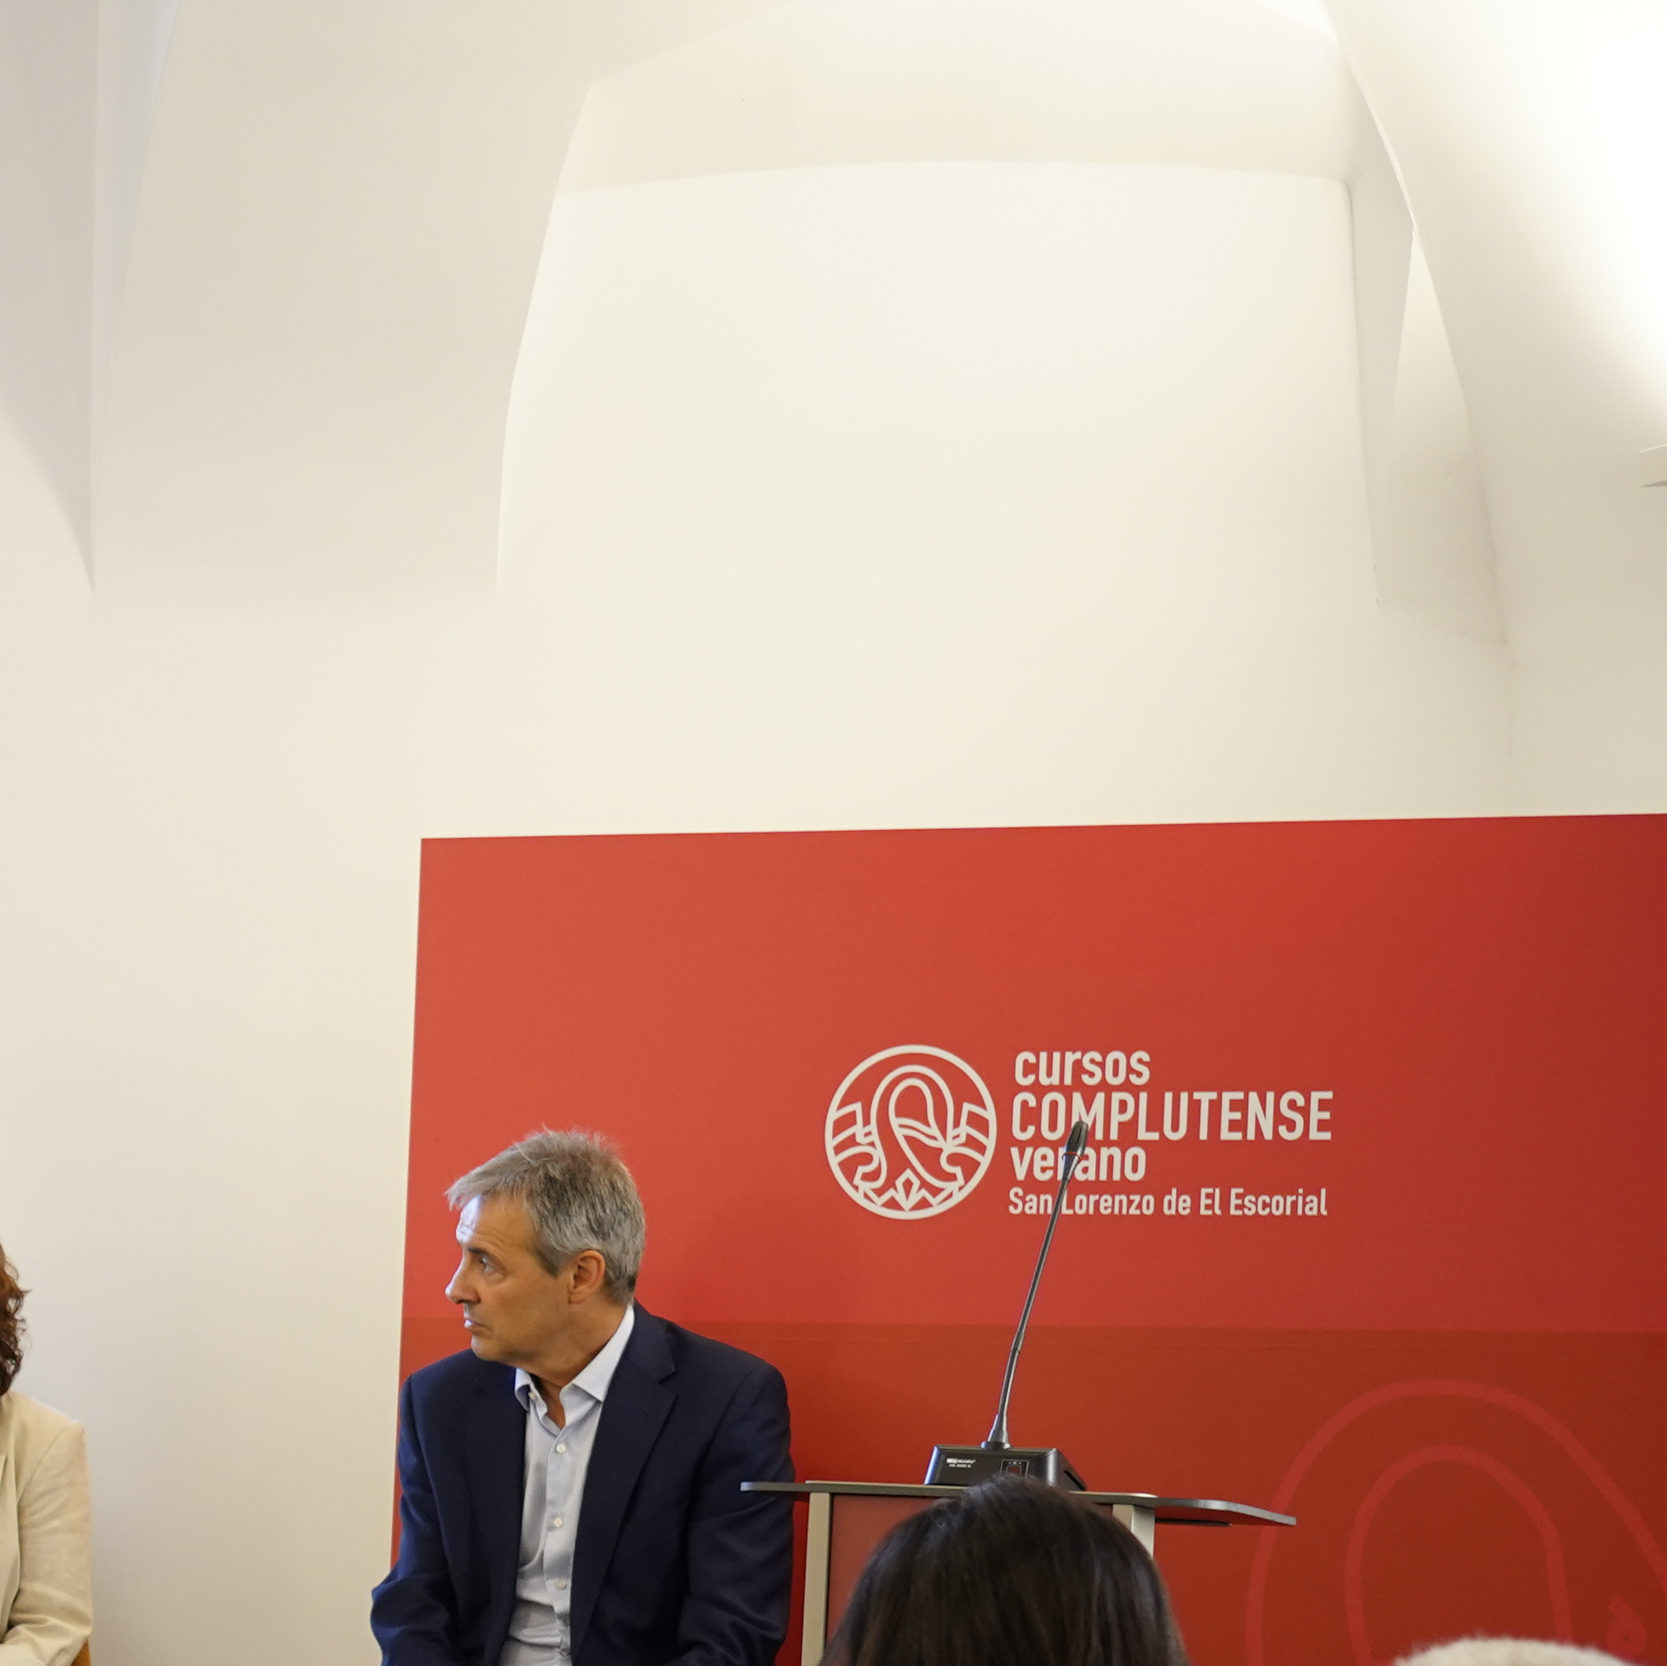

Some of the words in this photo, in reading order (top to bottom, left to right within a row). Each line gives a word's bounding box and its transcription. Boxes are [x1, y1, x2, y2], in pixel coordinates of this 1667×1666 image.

[1013, 1049, 1151, 1086] cursos
[1011, 1090, 1334, 1142] COMPLUTENSE
[1008, 1186, 1054, 1215] San
[1060, 1188, 1155, 1216] Lorenzo
[1162, 1187, 1191, 1217] de
[1199, 1187, 1223, 1217] El
[1229, 1188, 1329, 1217] Escorial
